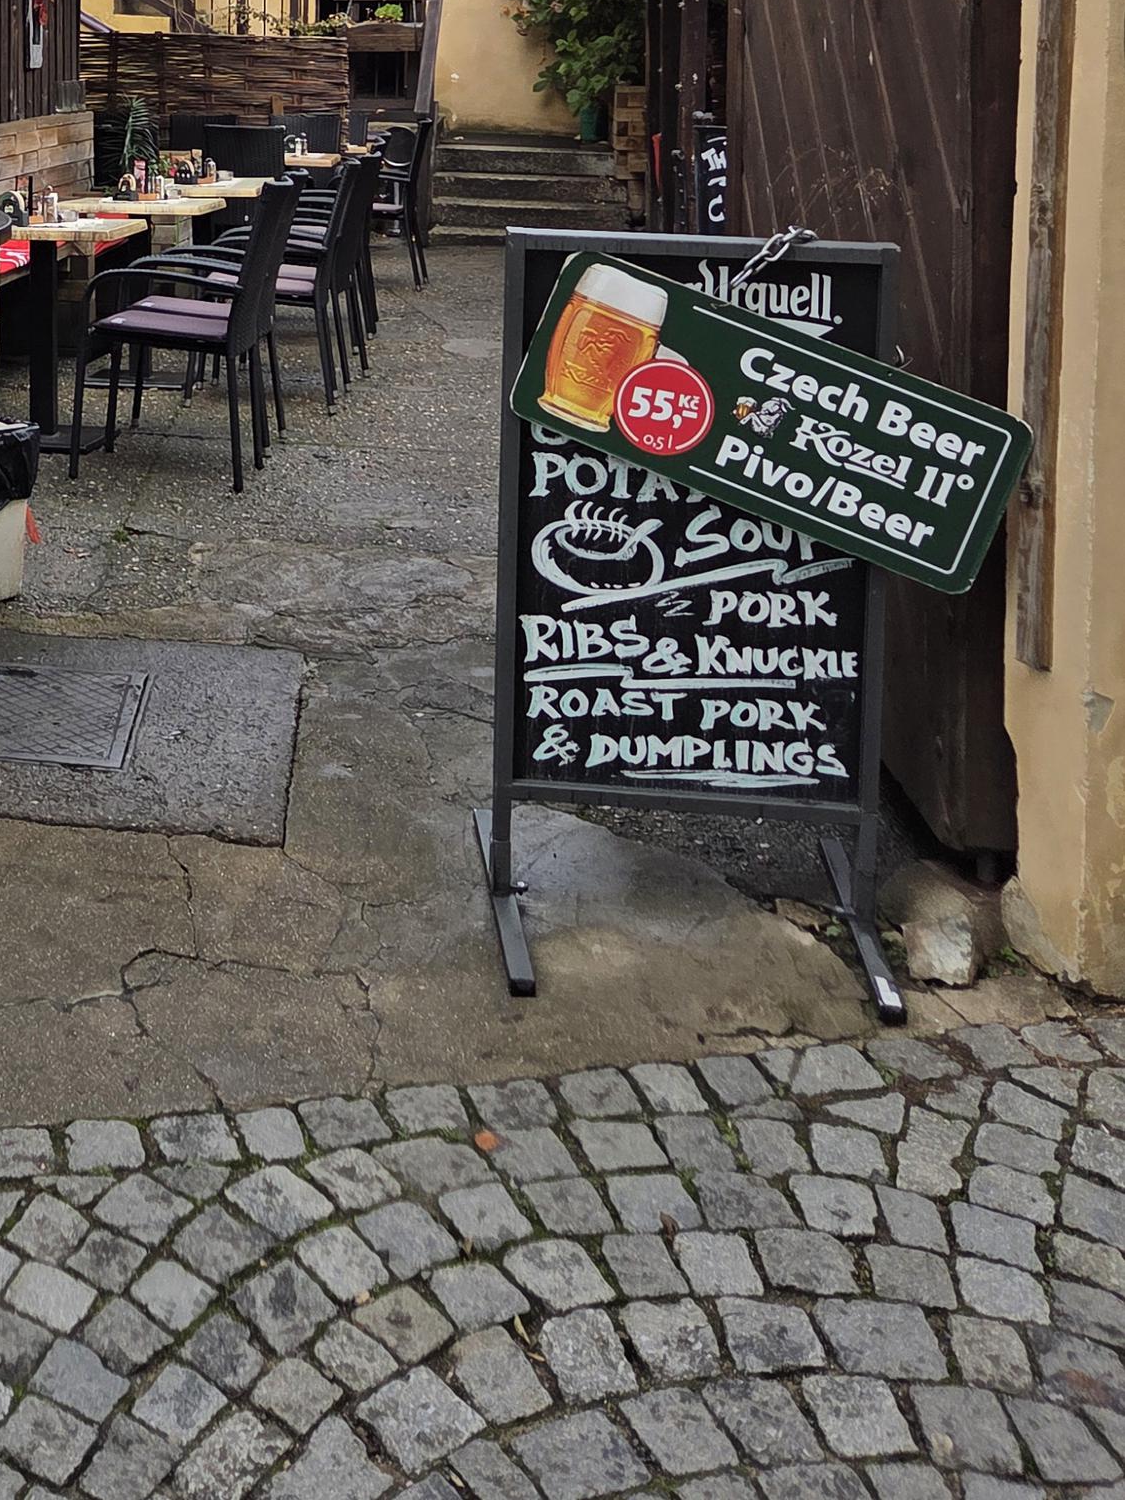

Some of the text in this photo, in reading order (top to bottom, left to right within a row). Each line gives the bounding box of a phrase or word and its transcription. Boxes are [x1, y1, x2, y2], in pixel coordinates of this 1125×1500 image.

[740, 347, 986, 467] Czech Beer
[789, 414, 913, 484] Kozel
[715, 434, 935, 548] Pivo/Beer
[702, 589, 838, 627] PORK
[518, 614, 858, 681] RIBS & KNUCKLE
[526, 684, 827, 731] ROAST PORK
[532, 724, 850, 778] & DUMPLINGS
